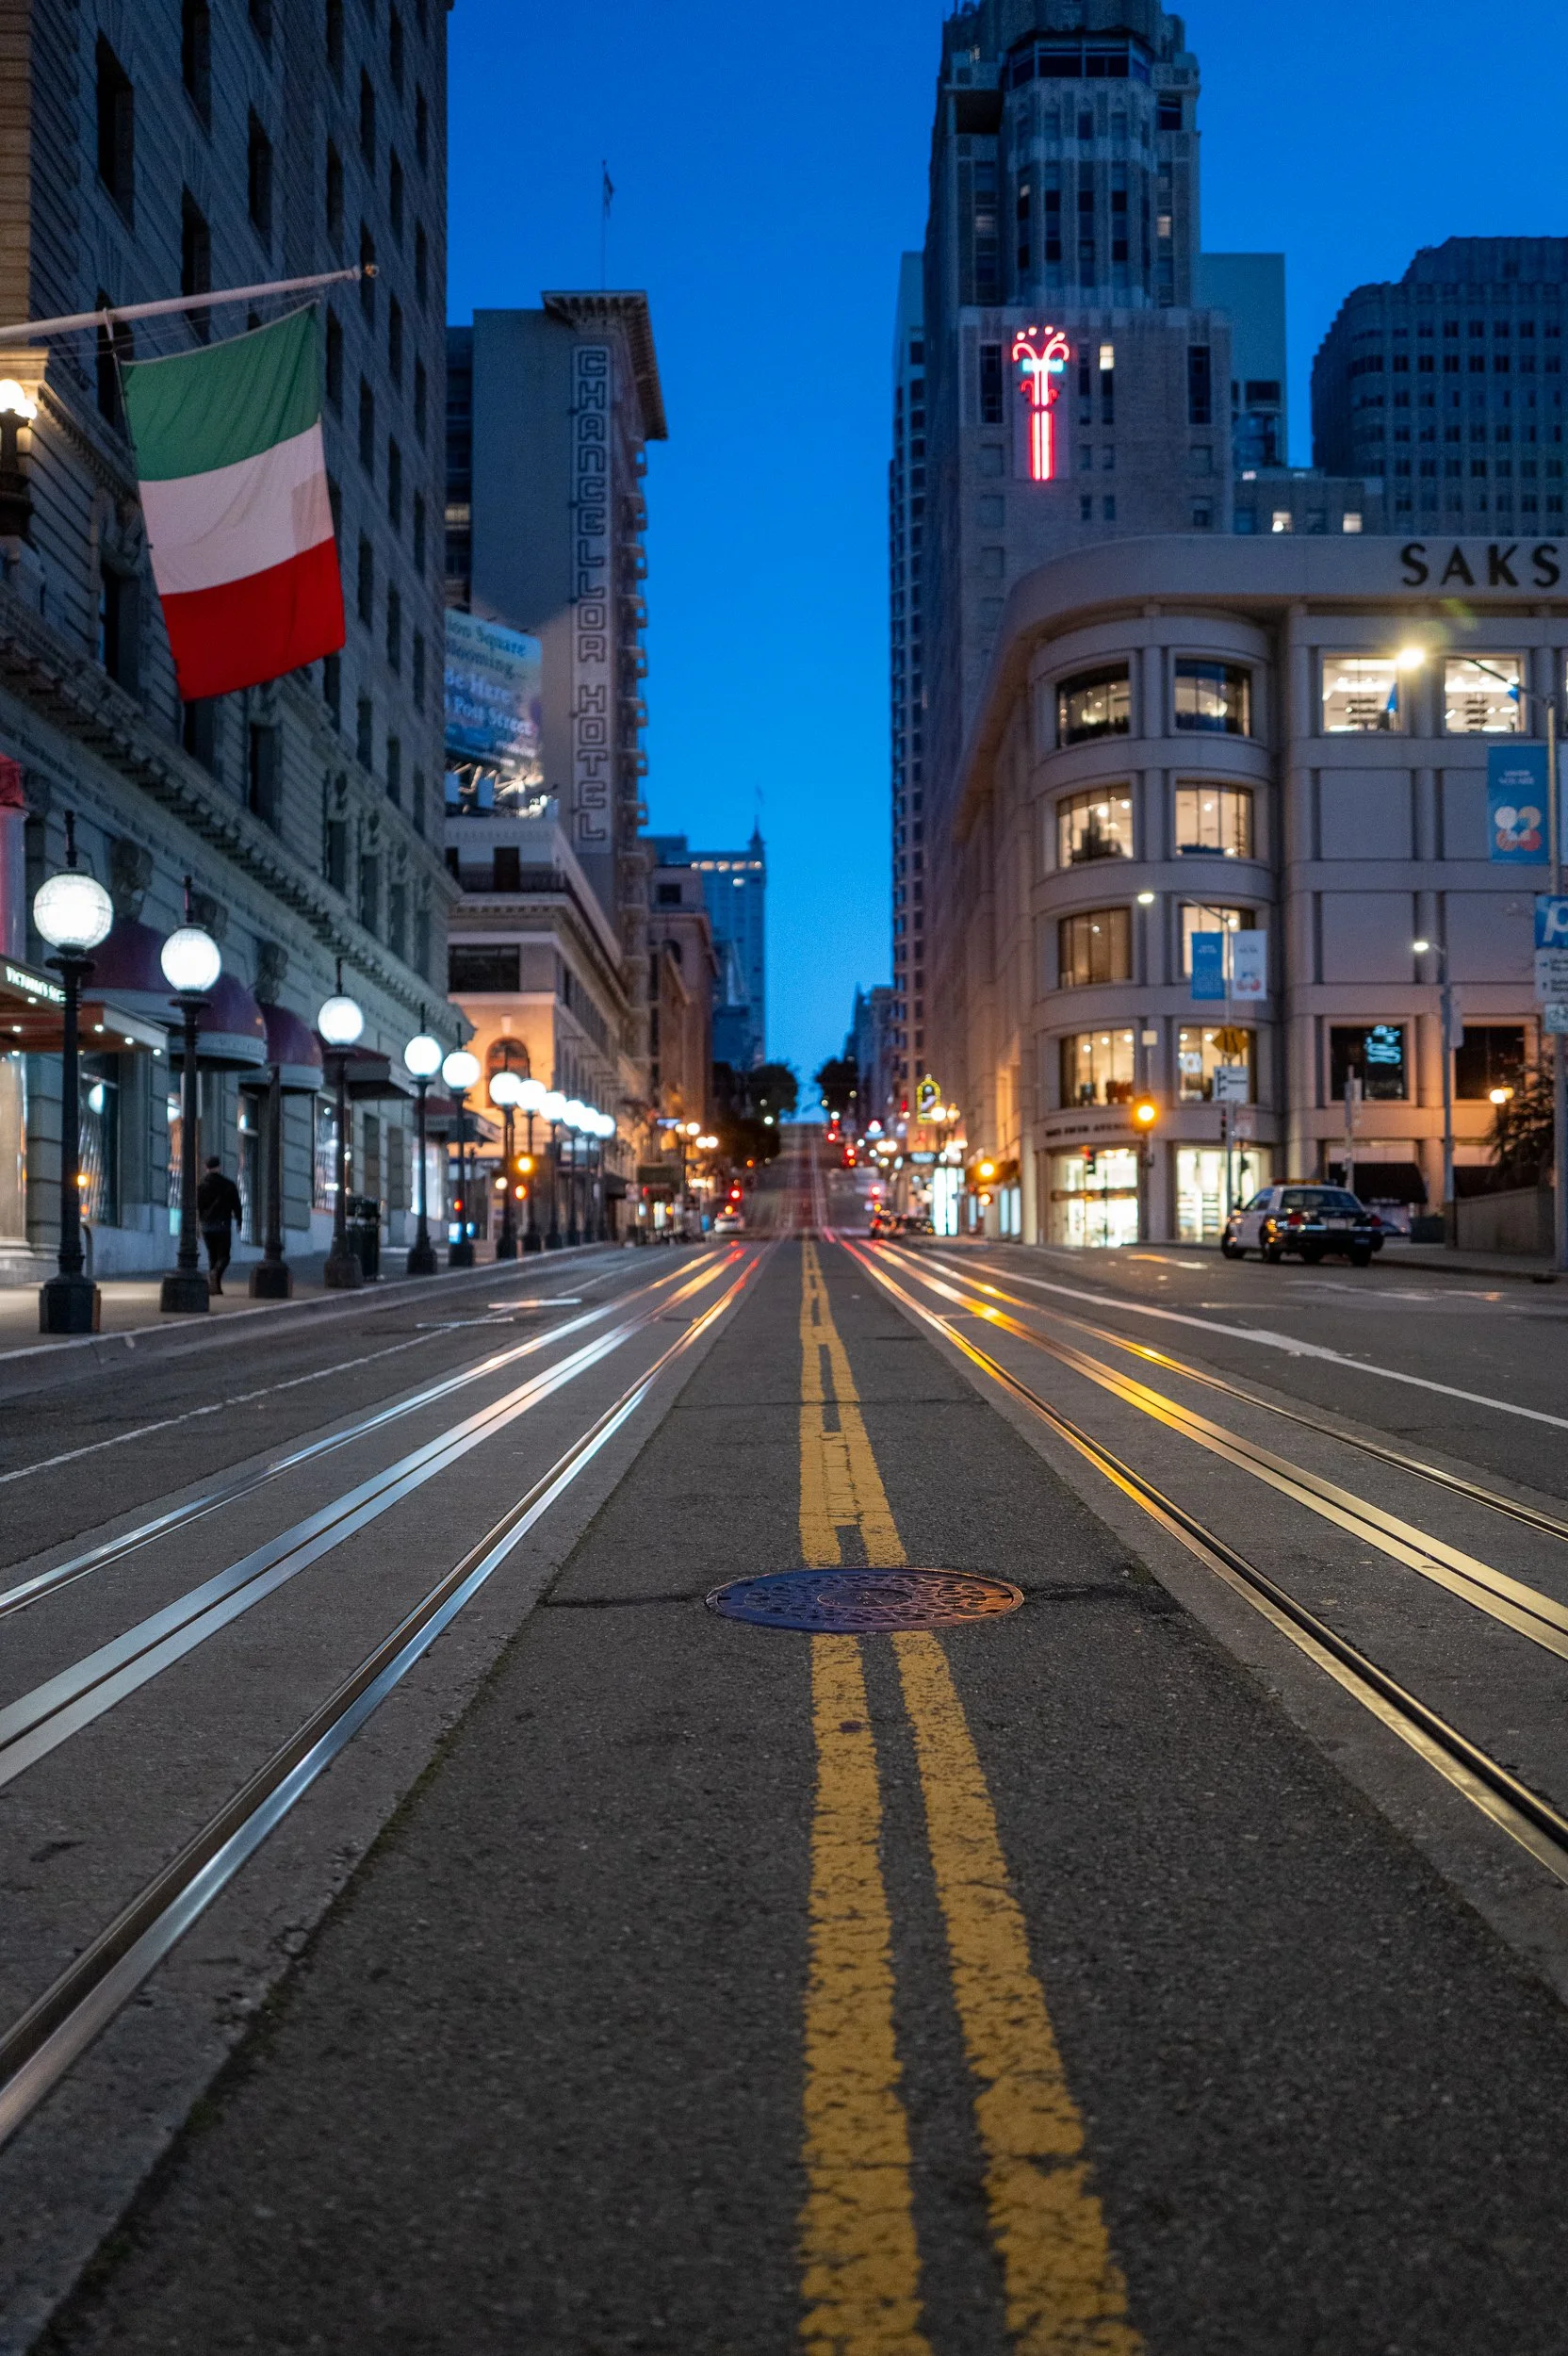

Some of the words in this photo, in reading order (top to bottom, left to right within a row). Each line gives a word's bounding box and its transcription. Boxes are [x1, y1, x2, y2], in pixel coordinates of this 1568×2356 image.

[577, 350, 607, 663] CHANCELLOR
[1399, 542, 1561, 588] SAKS
[577, 684, 609, 842] HOTEL
